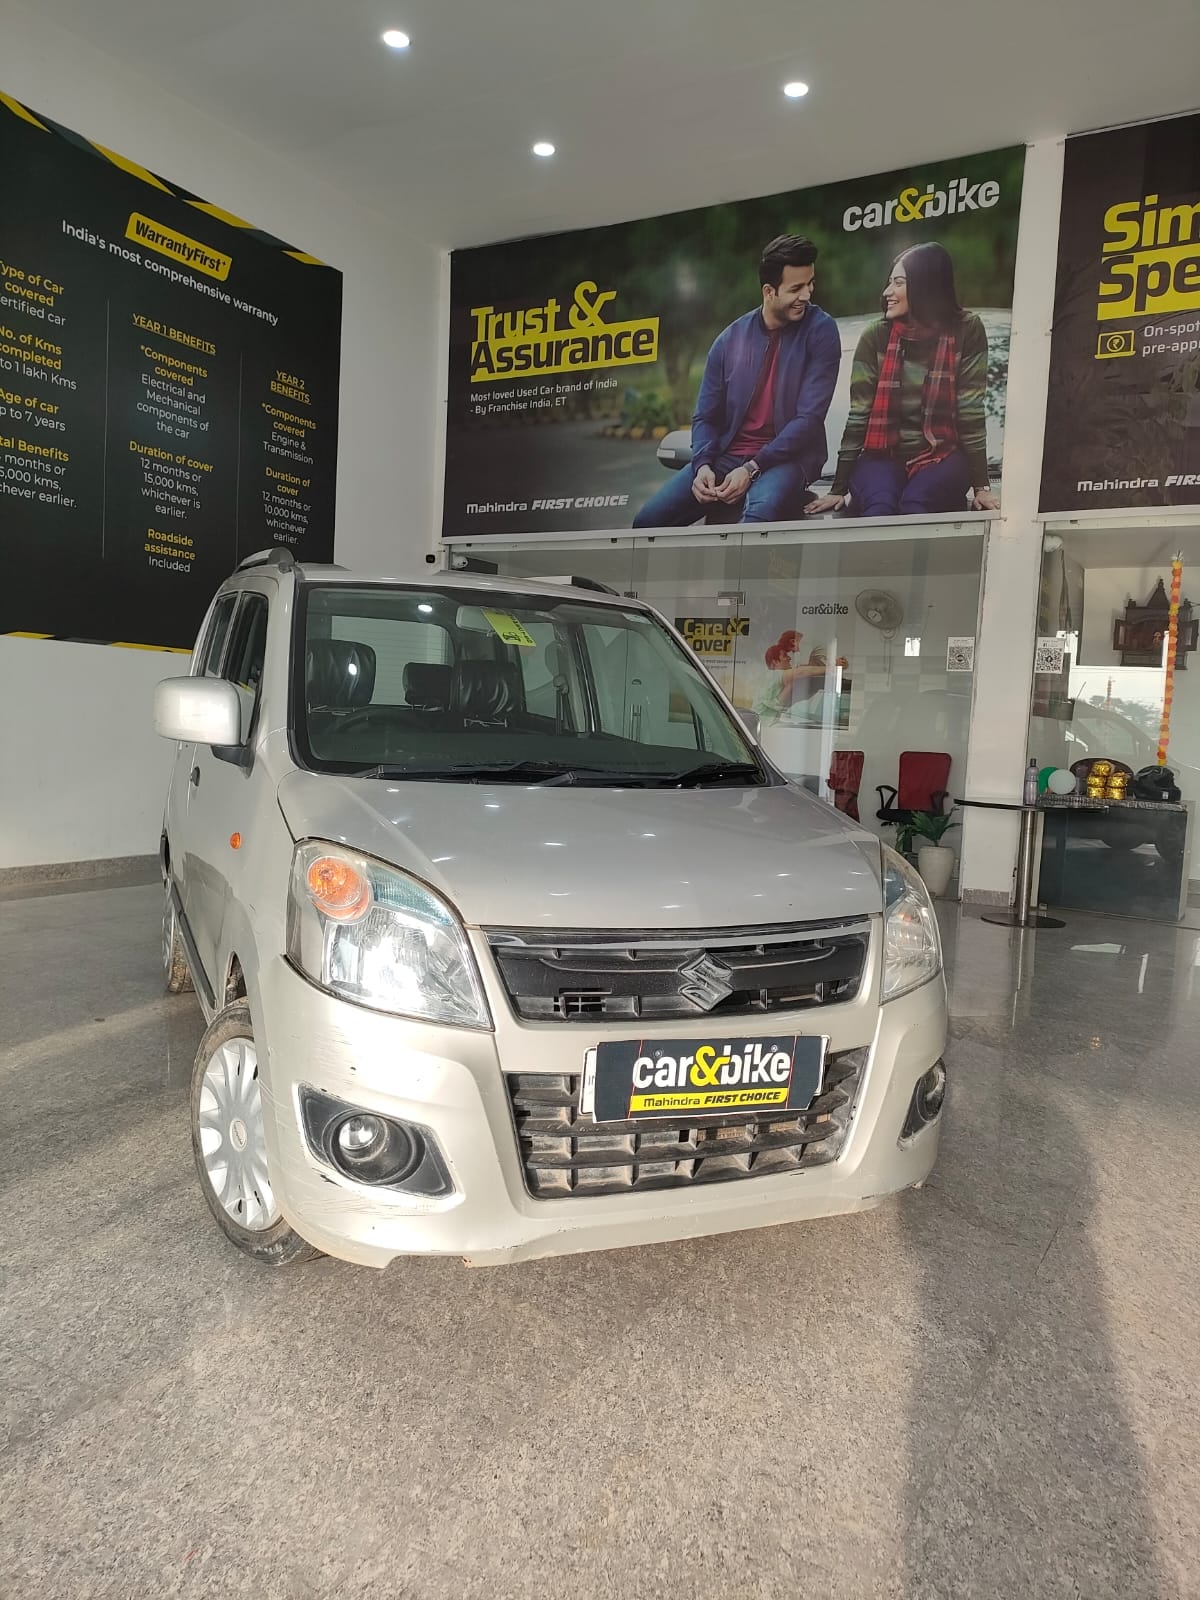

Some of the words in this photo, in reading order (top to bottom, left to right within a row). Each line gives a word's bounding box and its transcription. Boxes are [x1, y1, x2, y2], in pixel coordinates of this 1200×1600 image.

[842, 178, 1000, 232] car&bike
[0, 261, 25, 280] ype
[28, 275, 41, 287] of
[43, 279, 65, 295] Car
[62, 220, 106, 250] India's
[109, 242, 142, 266] most
[144, 258, 231, 305] comprehensive
[233, 297, 279, 326] warranty
[4, 281, 54, 307] covered
[47, 312, 66, 326] car
[471, 298, 560, 341] Trust
[569, 281, 617, 328] &
[19, 334, 32, 345] of
[35, 337, 62, 355] Kms
[132, 313, 161, 335] YEAR
[169, 328, 216, 355] BENEFITS
[471, 328, 655, 376] Assurance
[14, 361, 19, 373] 1
[22, 363, 48, 382] lakh
[51, 373, 77, 390] Kms
[154, 366, 194, 386] covered
[276, 370, 299, 387] YEAR
[141, 373, 186, 397] Electrical
[187, 391, 206, 404] and
[270, 380, 312, 406] BENEFITS
[471, 392, 491, 402] Most
[492, 389, 515, 400] loved
[516, 387, 538, 398] Used
[540, 384, 554, 395] Car
[556, 381, 582, 393] brand
[583, 381, 593, 391] of
[595, 378, 618, 389] India
[0, 388, 22, 404] Age
[25, 398, 38, 408] of
[40, 401, 60, 414] car
[146, 390, 201, 415] Mechanical
[475, 405, 487, 416] By
[488, 401, 528, 413] Franchise
[529, 397, 553, 409] India,
[555, 396, 567, 406] ET
[10, 408, 23, 420] to
[25, 411, 33, 422] 7
[34, 415, 66, 431] years
[136, 402, 198, 428] components
[199, 421, 210, 431] of
[156, 421, 173, 434] the
[174, 428, 190, 439] car
[273, 421, 305, 438] covered
[18, 439, 69, 461] Benefits
[271, 431, 300, 448] Engine
[300, 441, 307, 451] &
[129, 440, 174, 461] Duration
[175, 456, 187, 464] of
[187, 458, 214, 473] cover
[263, 440, 314, 465] Transmission
[4, 454, 52, 473] months
[54, 465, 67, 476] or
[140, 457, 151, 470] 12
[152, 462, 191, 480] months
[191, 474, 202, 483] or
[34, 474, 62, 491] kms,
[143, 472, 175, 489] 15,000
[176, 480, 199, 496] kms,
[265, 467, 301, 486] Duration
[302, 479, 311, 488] of
[1077, 478, 1159, 492] Mahindra
[38, 492, 77, 509] earlier.
[141, 488, 191, 507] whichever
[192, 498, 201, 509] is
[276, 484, 299, 496] cover
[155, 504, 188, 519] earlier.
[262, 490, 271, 501] 12
[271, 495, 302, 510] months
[302, 504, 312, 512] or
[263, 503, 290, 518] 10,000
[466, 502, 528, 514] Mahindra
[531, 499, 574, 511] FIRST
[574, 495, 630, 508] CHOICE
[147, 528, 194, 547] Roadside
[266, 519, 307, 535] whichever
[273, 532, 300, 545] earlier.
[144, 543, 196, 561] assistance
[148, 556, 191, 572] Included
[801, 603, 849, 615] car&bike
[683, 619, 723, 636] Care
[632, 1043, 791, 1089] car&bike
[643, 1096, 700, 1107] Mahindra
[704, 1093, 738, 1104] FIRST
[740, 1091, 781, 1102] CHOICE
